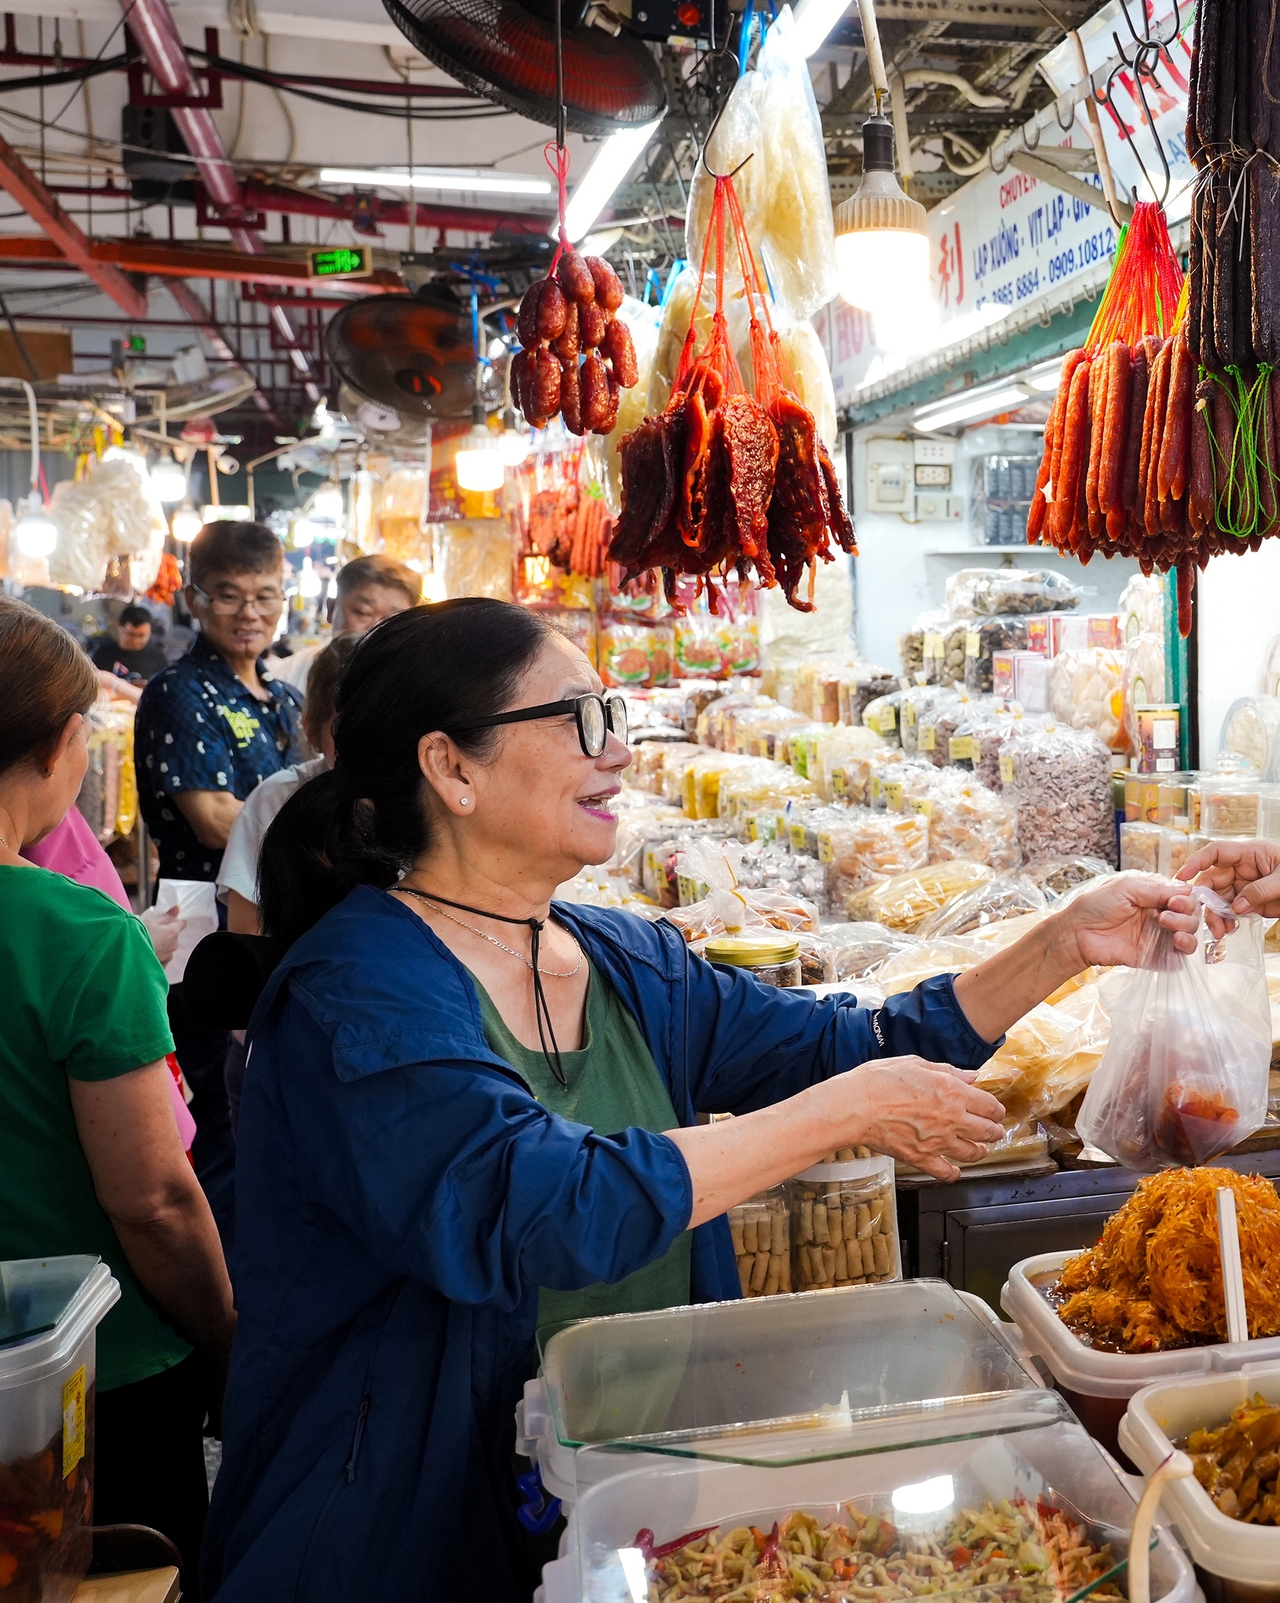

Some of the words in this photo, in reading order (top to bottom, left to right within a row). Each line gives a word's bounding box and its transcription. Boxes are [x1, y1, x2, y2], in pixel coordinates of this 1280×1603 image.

[1046, 194, 1064, 247] LẠP
[1016, 267, 1040, 300] 8884
[1049, 226, 1119, 283] 0909.10812
